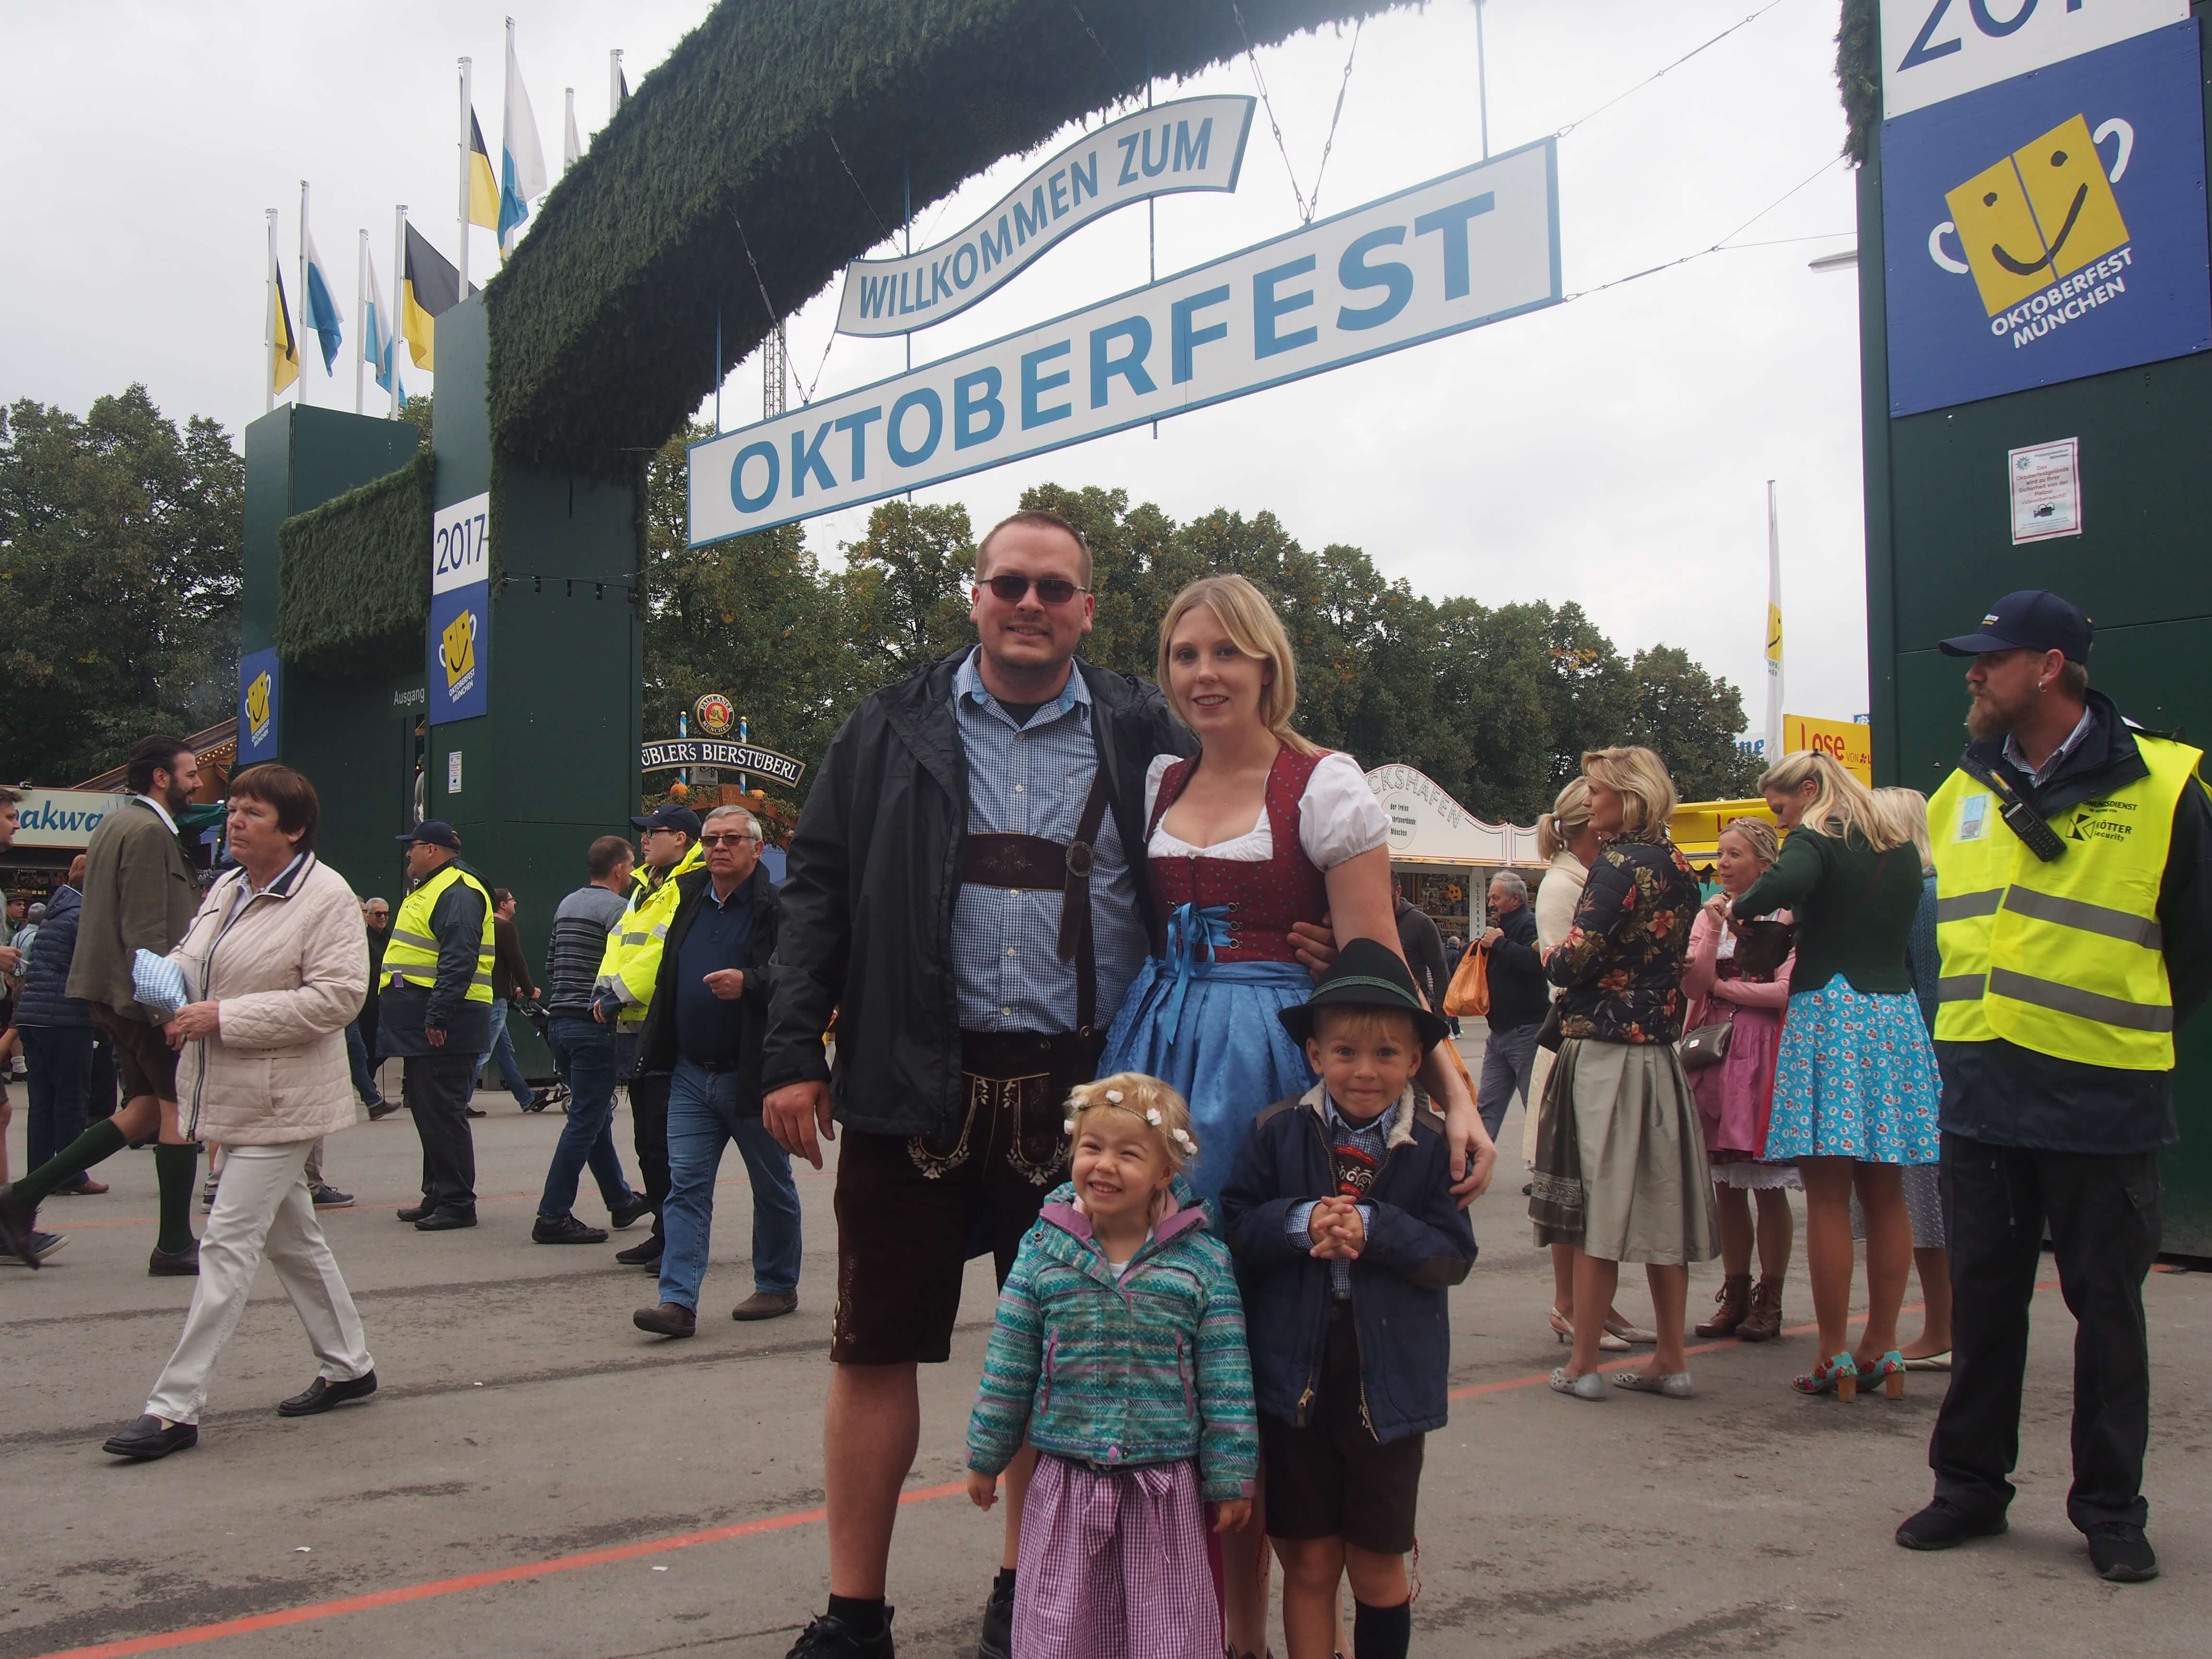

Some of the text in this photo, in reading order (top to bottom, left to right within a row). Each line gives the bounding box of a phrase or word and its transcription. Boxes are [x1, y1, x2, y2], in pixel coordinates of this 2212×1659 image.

[860, 117, 1213, 319] WILLKOMMEN ZUM
[1991, 247, 2132, 336] OKTOBERFEST
[2013, 276, 2126, 349] MÜNCHEN
[730, 191, 1495, 514] OKTOBERFEST
[436, 513, 485, 576] 2017
[394, 687, 425, 706] Ausgang
[449, 668, 475, 697] OKTOBERFEST
[453, 680, 473, 703] MÜNCHEN
[700, 697, 733, 713] PAULANER
[1801, 721, 1845, 761] Lose
[1846, 752, 1859, 763] VON
[702, 744, 795, 781] BIERSTÜBERL
[1398, 804, 1409, 812] freien
[1391, 827, 1407, 836] München
